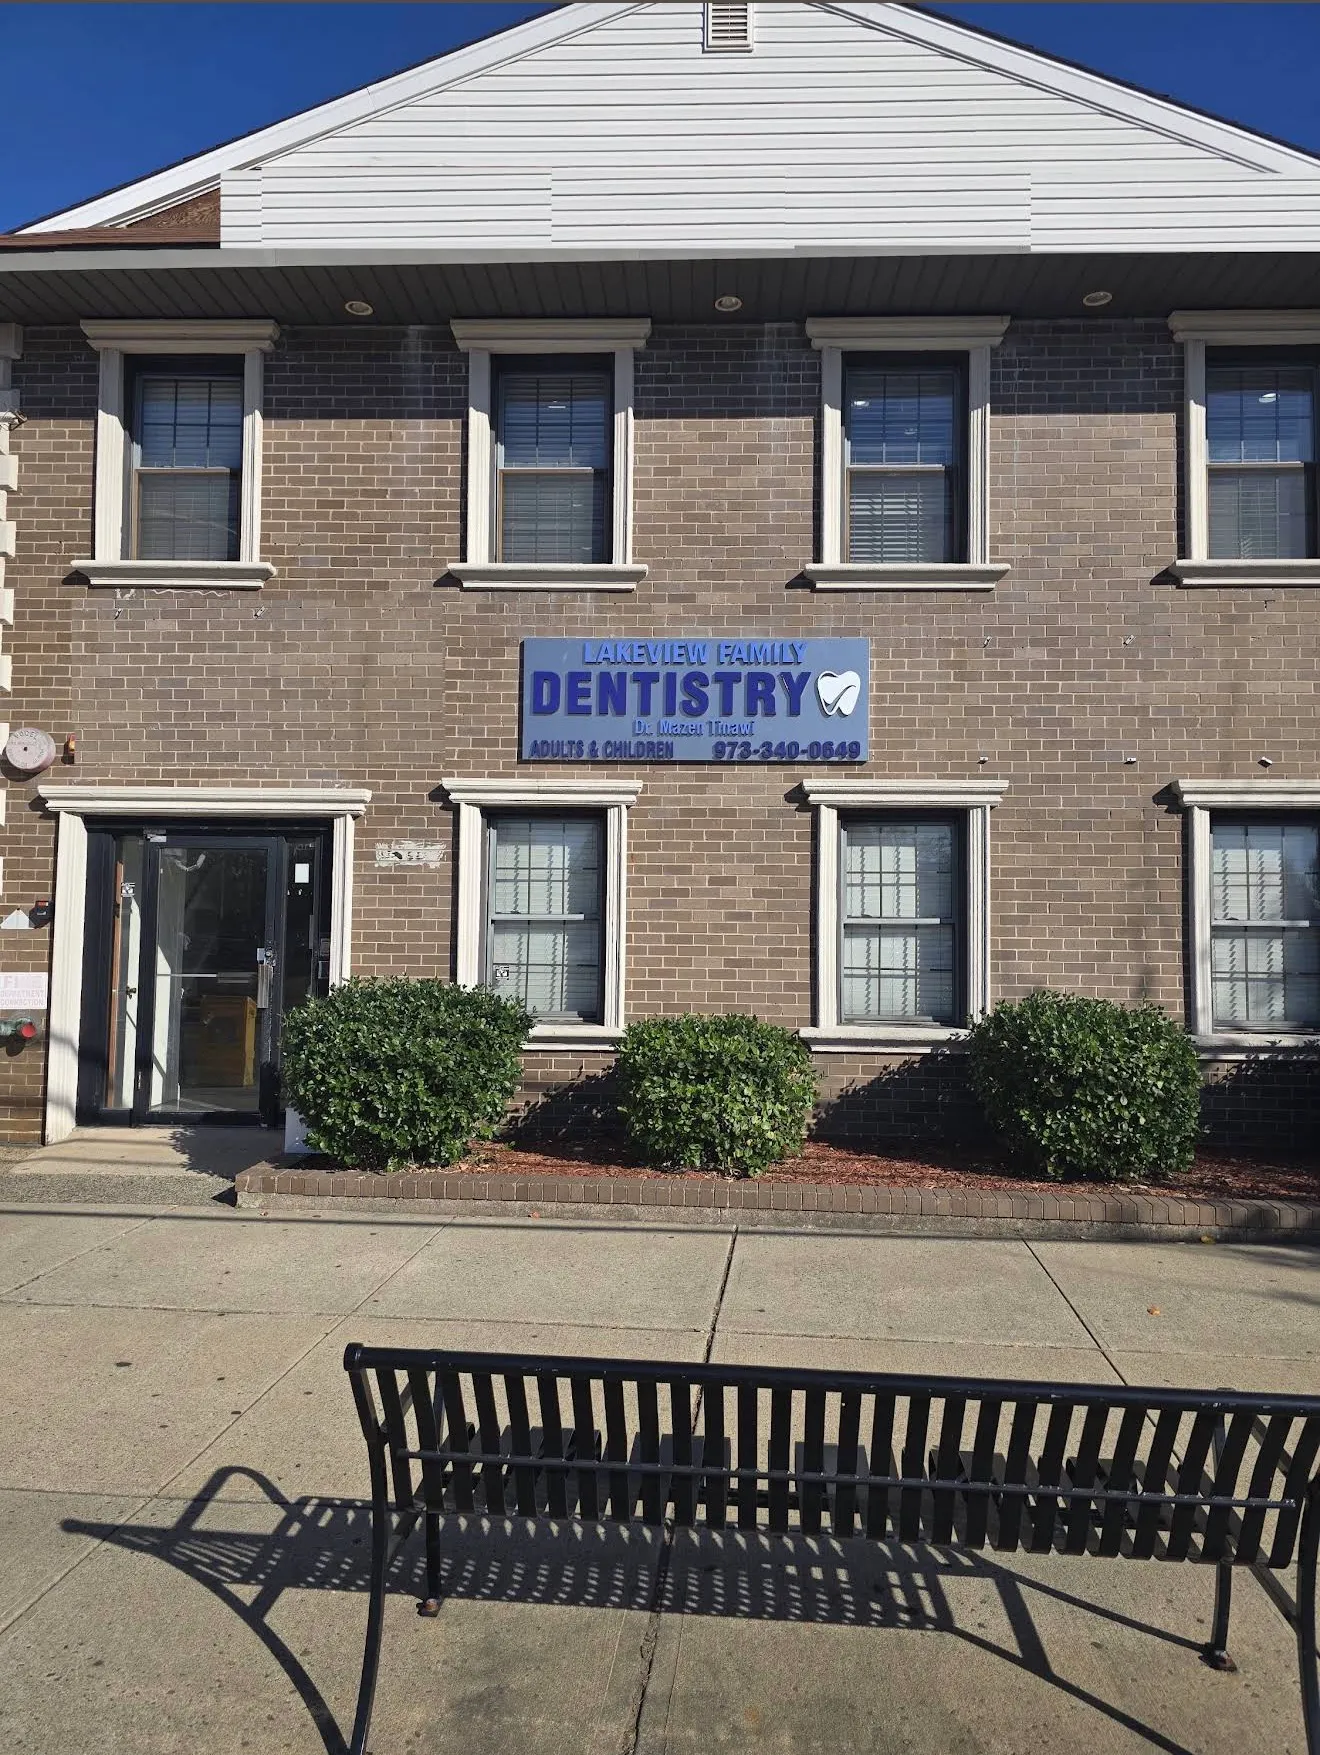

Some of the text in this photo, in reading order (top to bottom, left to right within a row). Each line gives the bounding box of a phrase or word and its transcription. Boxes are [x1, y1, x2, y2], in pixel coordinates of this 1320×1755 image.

[582, 642, 808, 665] LAKEVIEW FAMILY
[530, 671, 811, 717] DENTISTRY
[633, 719, 654, 736] Dr.
[658, 719, 705, 736] Mazen
[529, 740, 674, 759] ADULTS & CHILDREN
[712, 740, 861, 760] 973-340-0649
